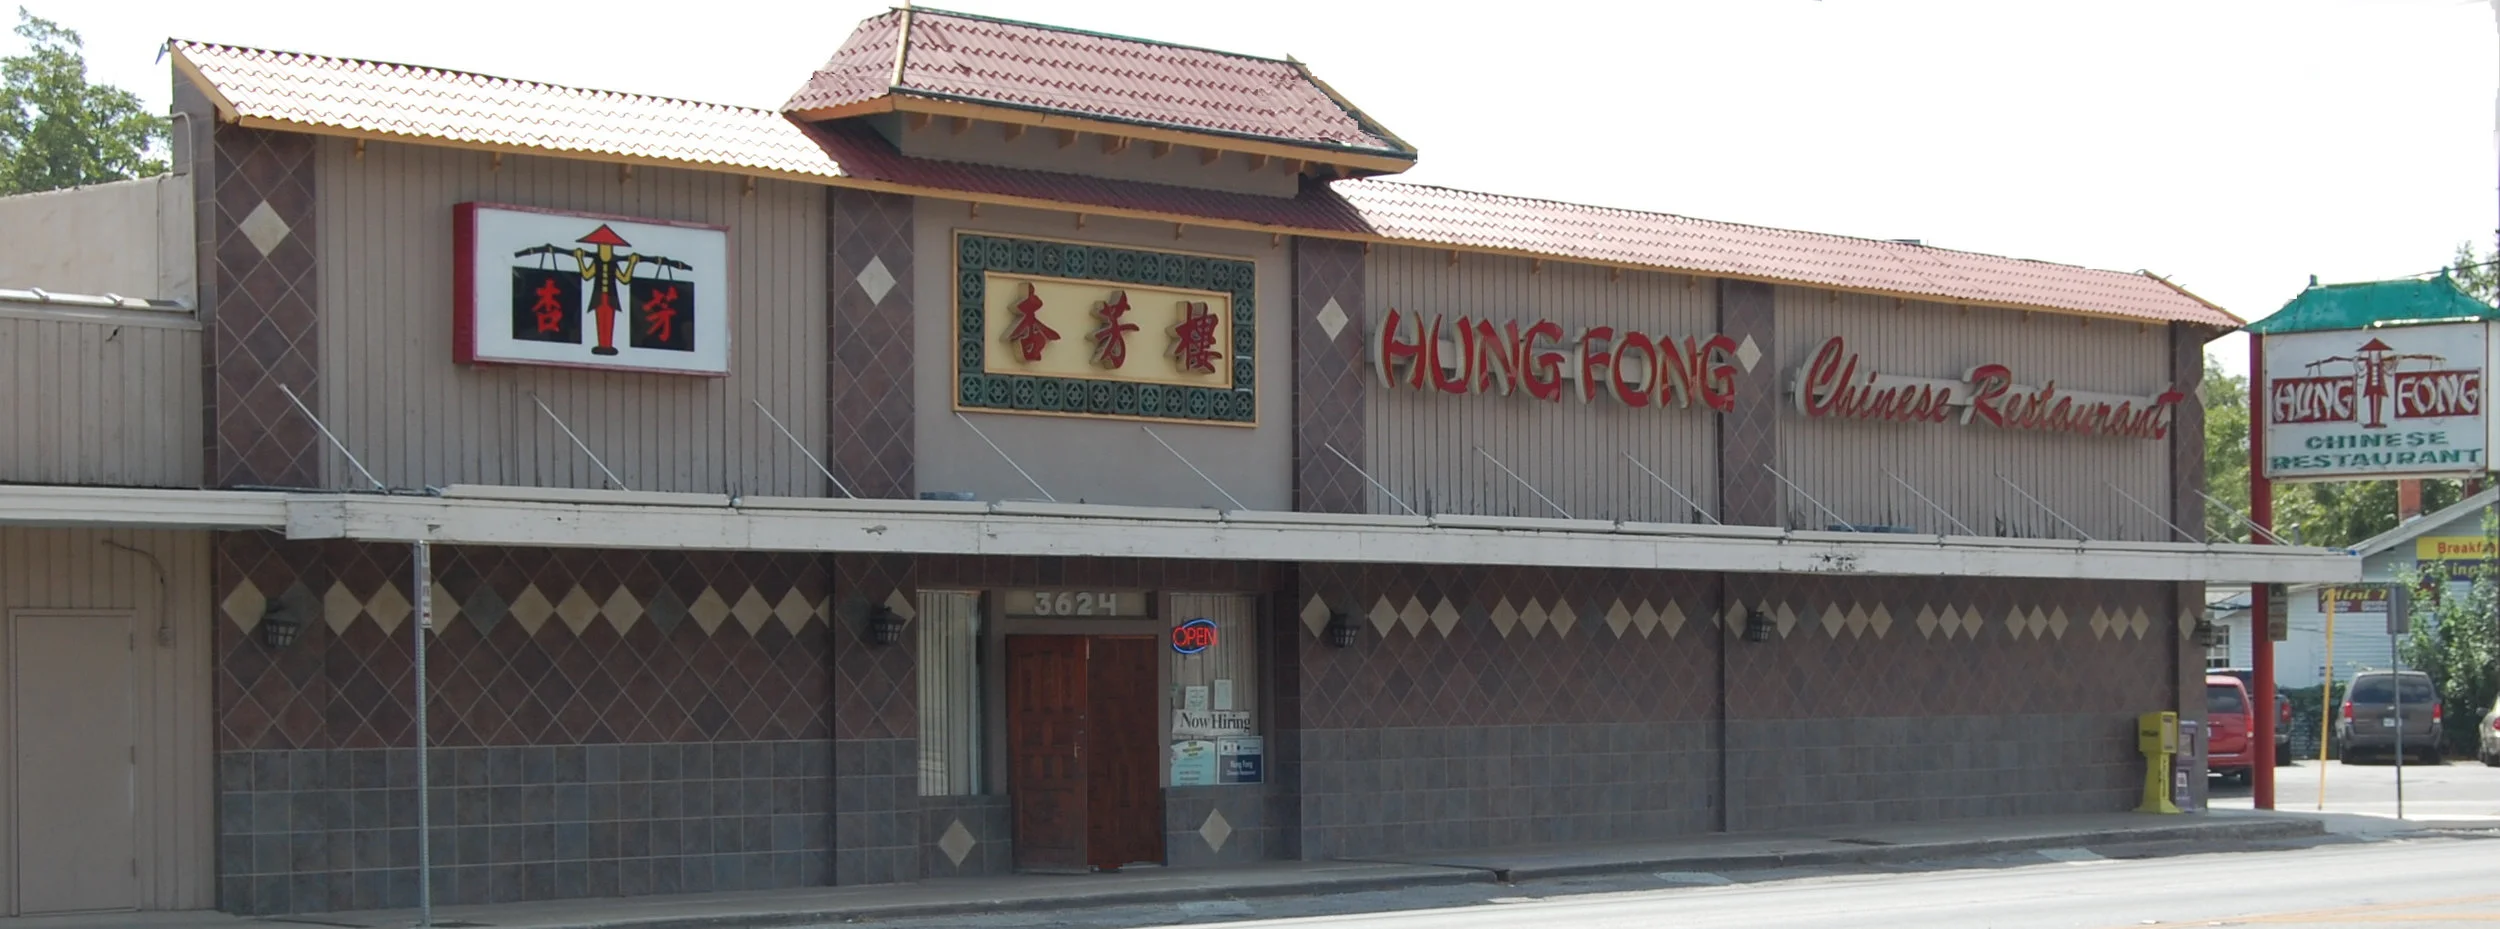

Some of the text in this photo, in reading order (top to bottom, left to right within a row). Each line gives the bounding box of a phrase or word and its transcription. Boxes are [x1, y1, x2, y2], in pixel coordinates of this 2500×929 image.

[531, 278, 564, 334] 杏
[1001, 281, 1223, 375] 杏芳樓
[1375, 306, 1738, 414] HUNG FONG
[1797, 335, 2185, 441] Chinese Restaurant
[2272, 373, 2480, 422] HUNG FONG
[2305, 431, 2448, 449] CHINESE
[2272, 448, 2483, 470] RESTAURANT
[1034, 591, 1117, 616] 3624
[1172, 626, 1218, 647] OPEN
[1179, 711, 1251, 733] Now Hiring
